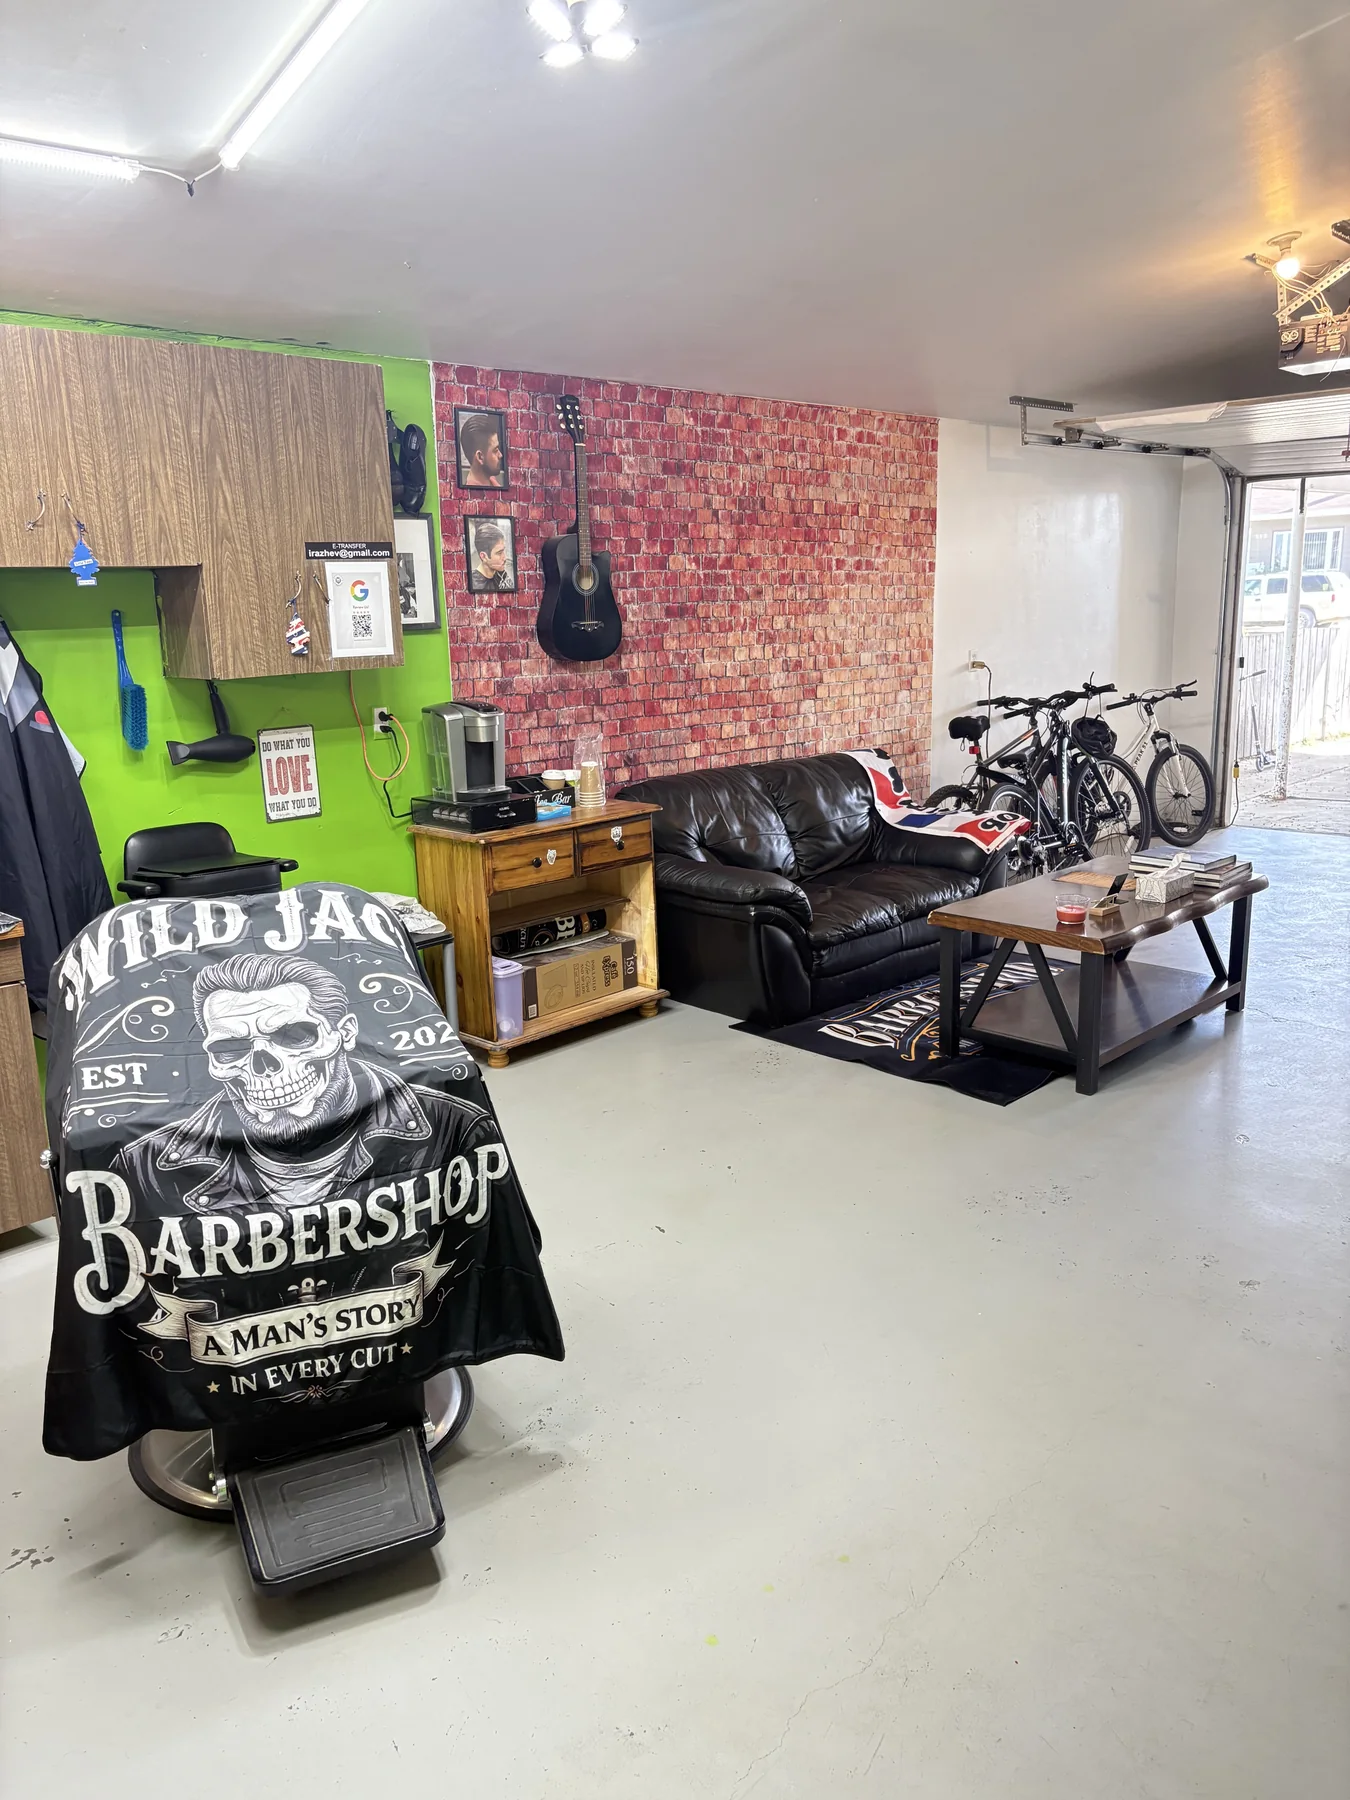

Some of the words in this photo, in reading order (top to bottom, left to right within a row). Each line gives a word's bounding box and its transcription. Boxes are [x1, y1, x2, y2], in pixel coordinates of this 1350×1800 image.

[308, 549, 390, 558] irazhev@gmail.com
[350, 580, 369, 602] G
[262, 741, 272, 752] DO
[273, 739, 294, 751] WHAT
[296, 737, 311, 748] YOU
[266, 754, 313, 796] LOVE
[268, 800, 289, 813] WHAT
[291, 798, 306, 810] YOU
[307, 797, 317, 808] DO
[551, 791, 572, 804] Bar
[57, 899, 249, 1022] WILD
[263, 887, 416, 971] JAC
[626, 956, 635, 975] 150
[81, 1061, 148, 1091] EST
[389, 1021, 460, 1051] 202
[65, 1142, 509, 1315] BARBERSHOP
[202, 1335, 226, 1356] A
[230, 1312, 328, 1355] MAN'S
[335, 1294, 420, 1332] STORY
[230, 1373, 258, 1395] IN
[264, 1352, 345, 1389] EVERY
[350, 1343, 398, 1369] CUT
